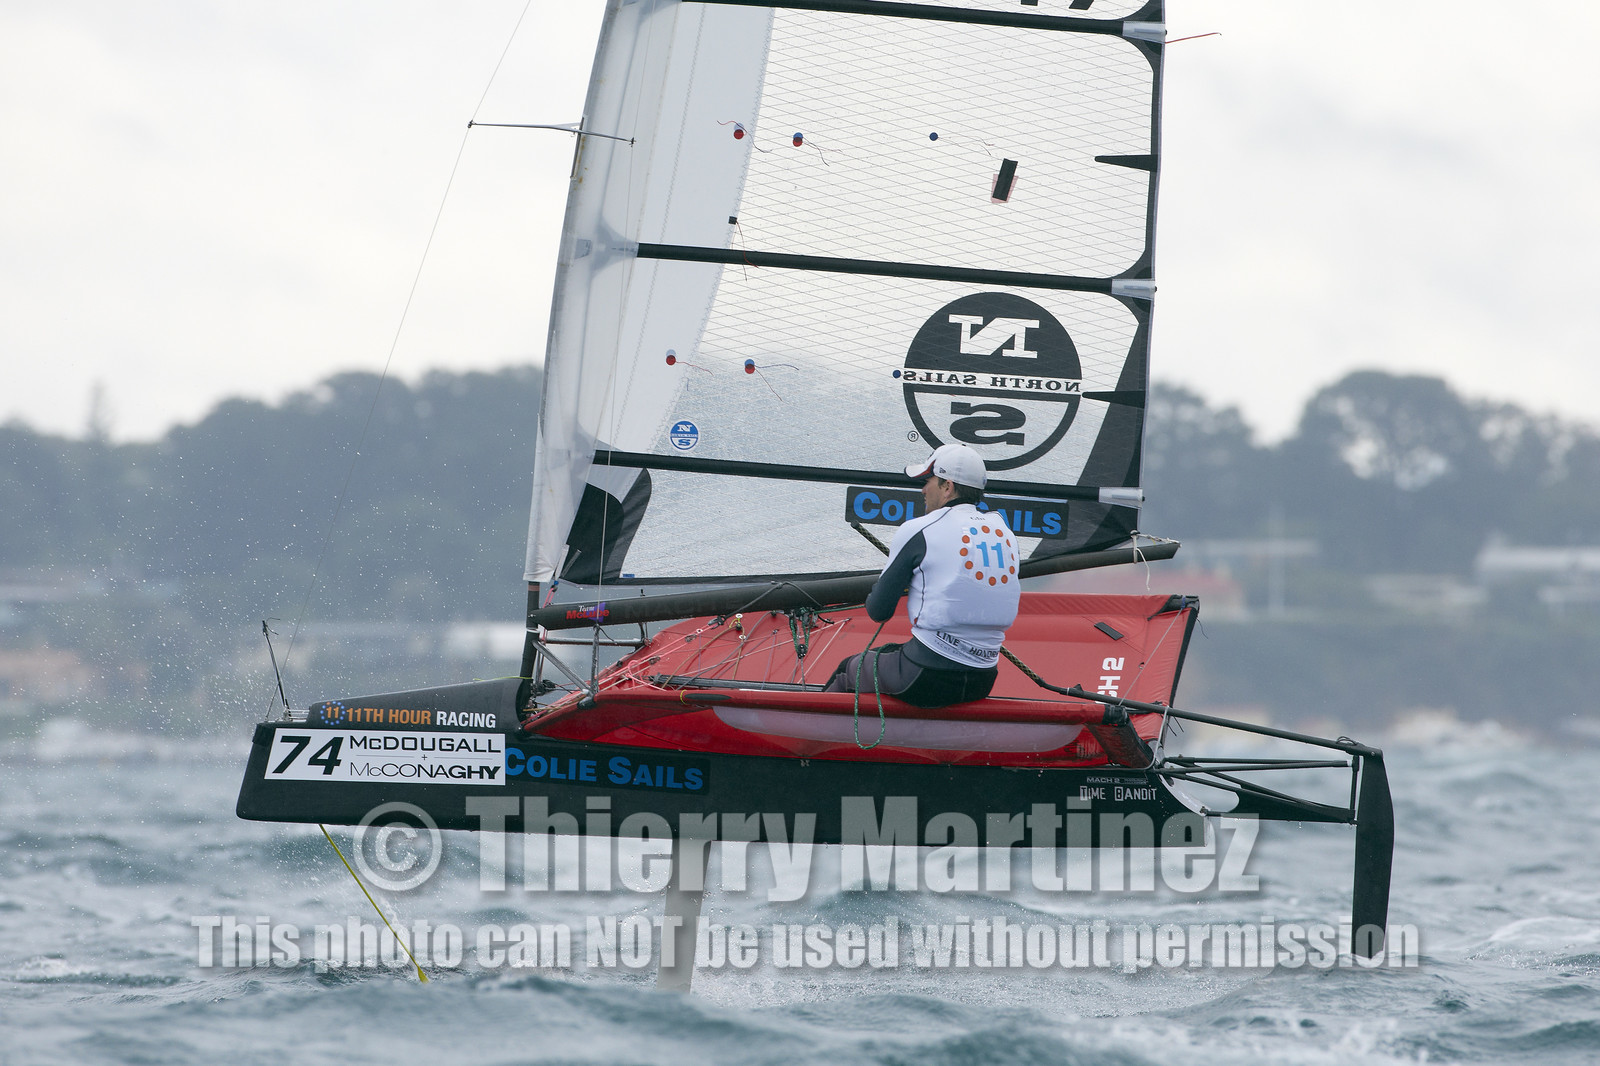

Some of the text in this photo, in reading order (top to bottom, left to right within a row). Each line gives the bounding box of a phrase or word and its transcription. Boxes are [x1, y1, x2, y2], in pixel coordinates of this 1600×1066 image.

[854, 491, 924, 521] COL
[976, 541, 1005, 569] 11
[937, 631, 960, 646] LINE
[1102, 657, 1125, 671] 2
[326, 707, 339, 718] 11
[346, 708, 496, 728] 11TH HOUR RACING
[272, 736, 344, 775] 74
[607, 756, 703, 790] SAILS
[1080, 785, 1157, 801] TIME BANDIT
